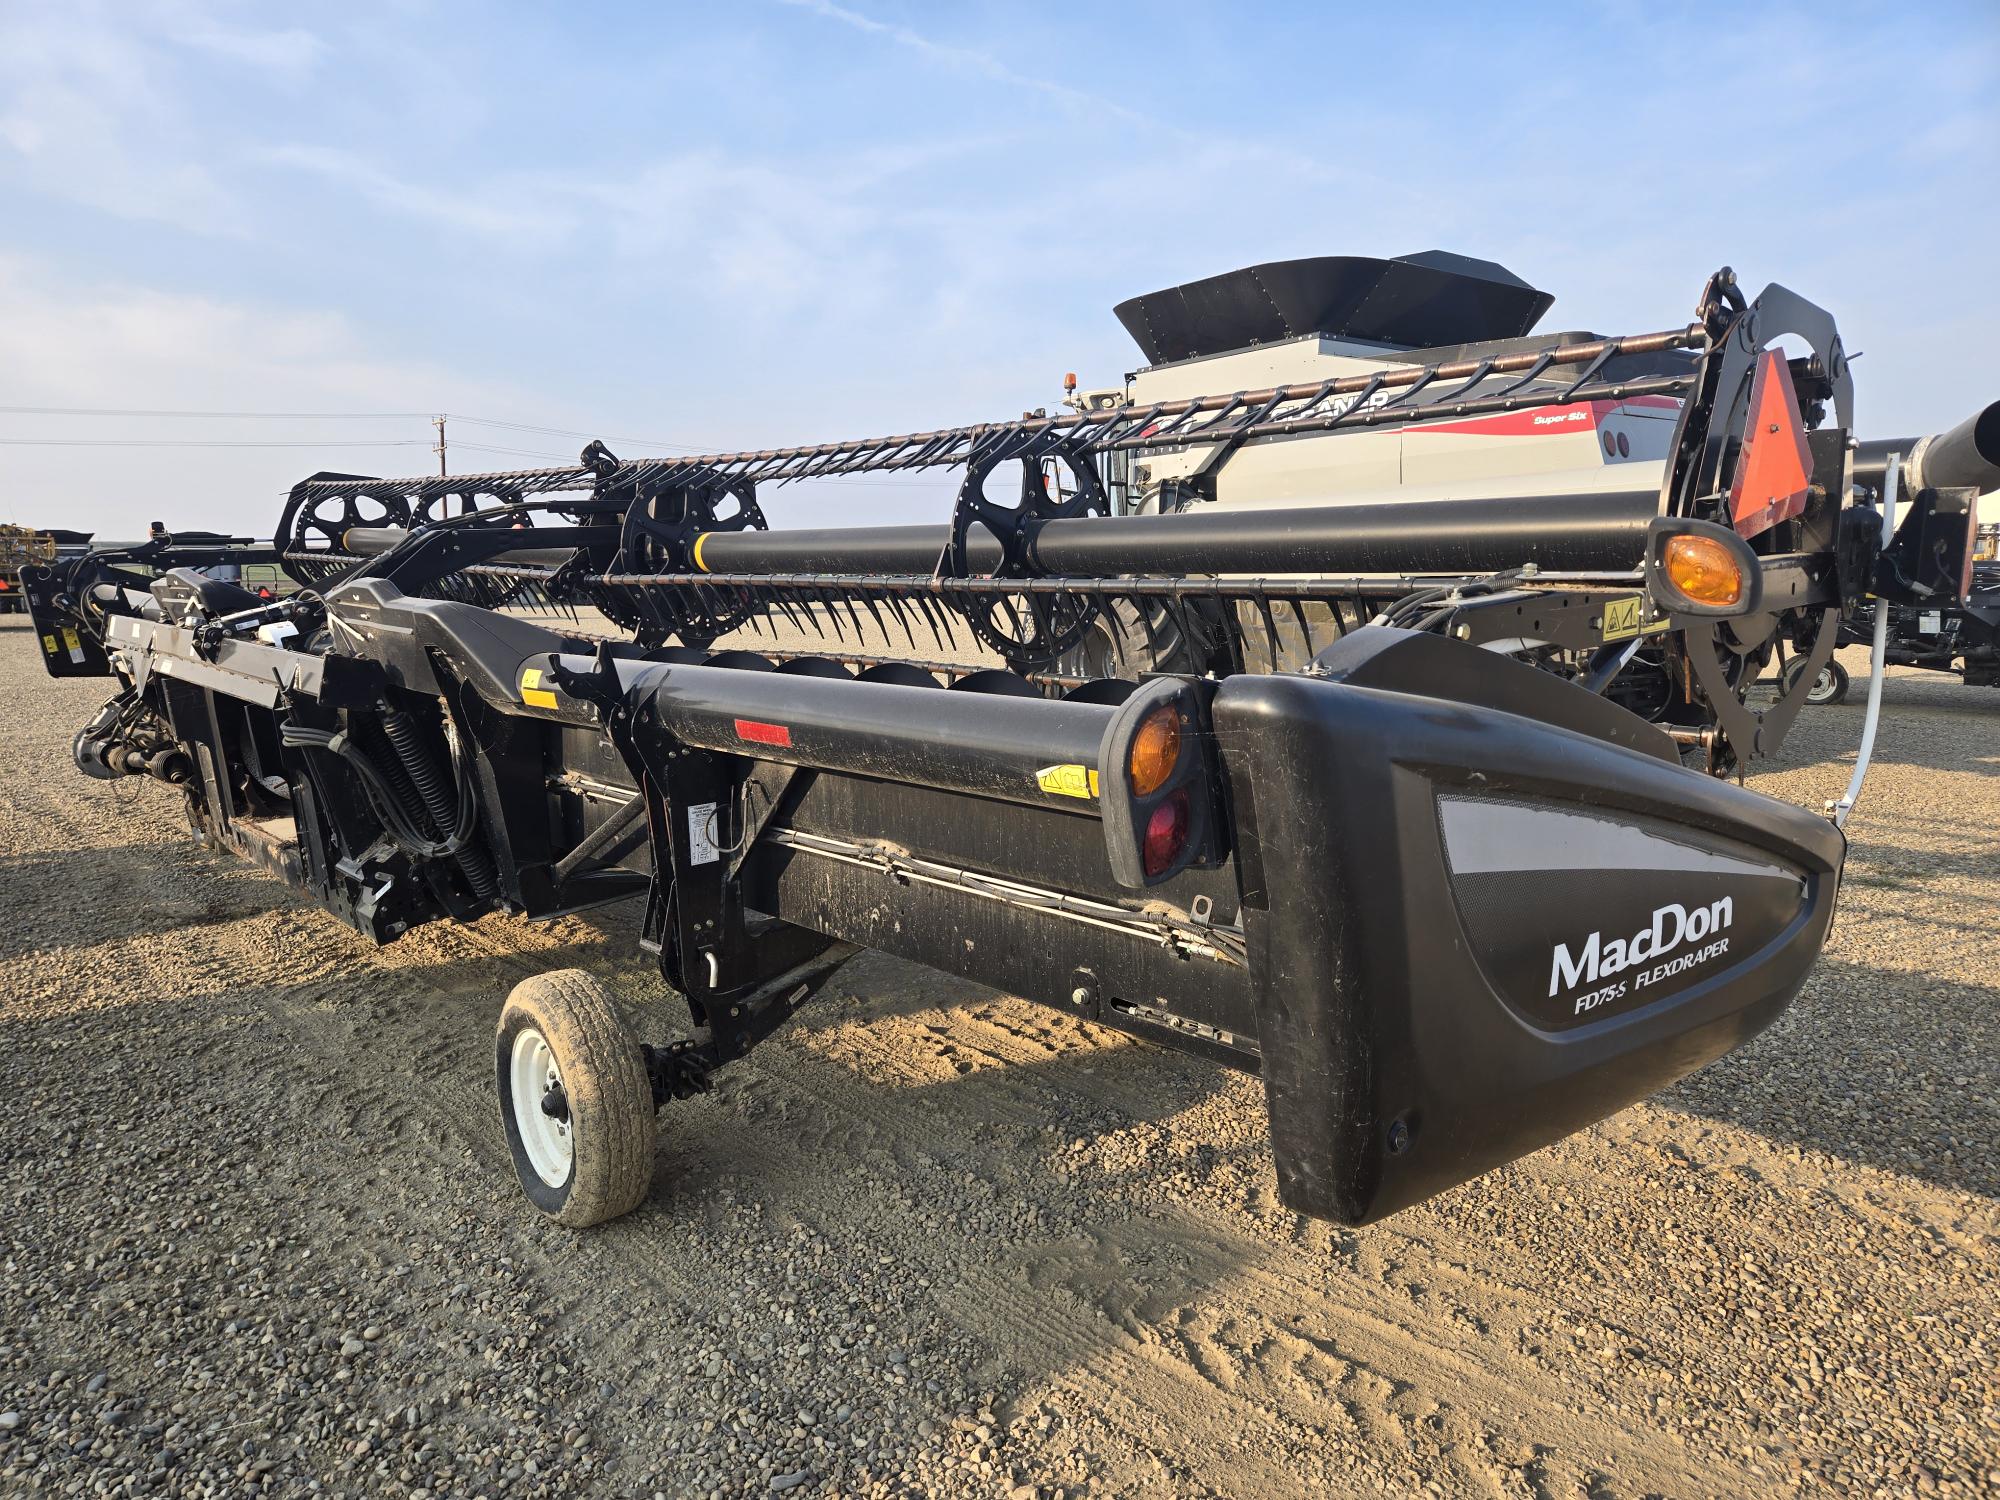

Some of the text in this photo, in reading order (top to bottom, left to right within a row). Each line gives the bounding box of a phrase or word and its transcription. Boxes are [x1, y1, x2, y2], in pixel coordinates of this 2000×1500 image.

[1534, 412, 1587, 425] Super Six
[1548, 895, 1733, 997] MacDon
[1574, 938, 1729, 1015] FD75-S FLEXDRAPER
